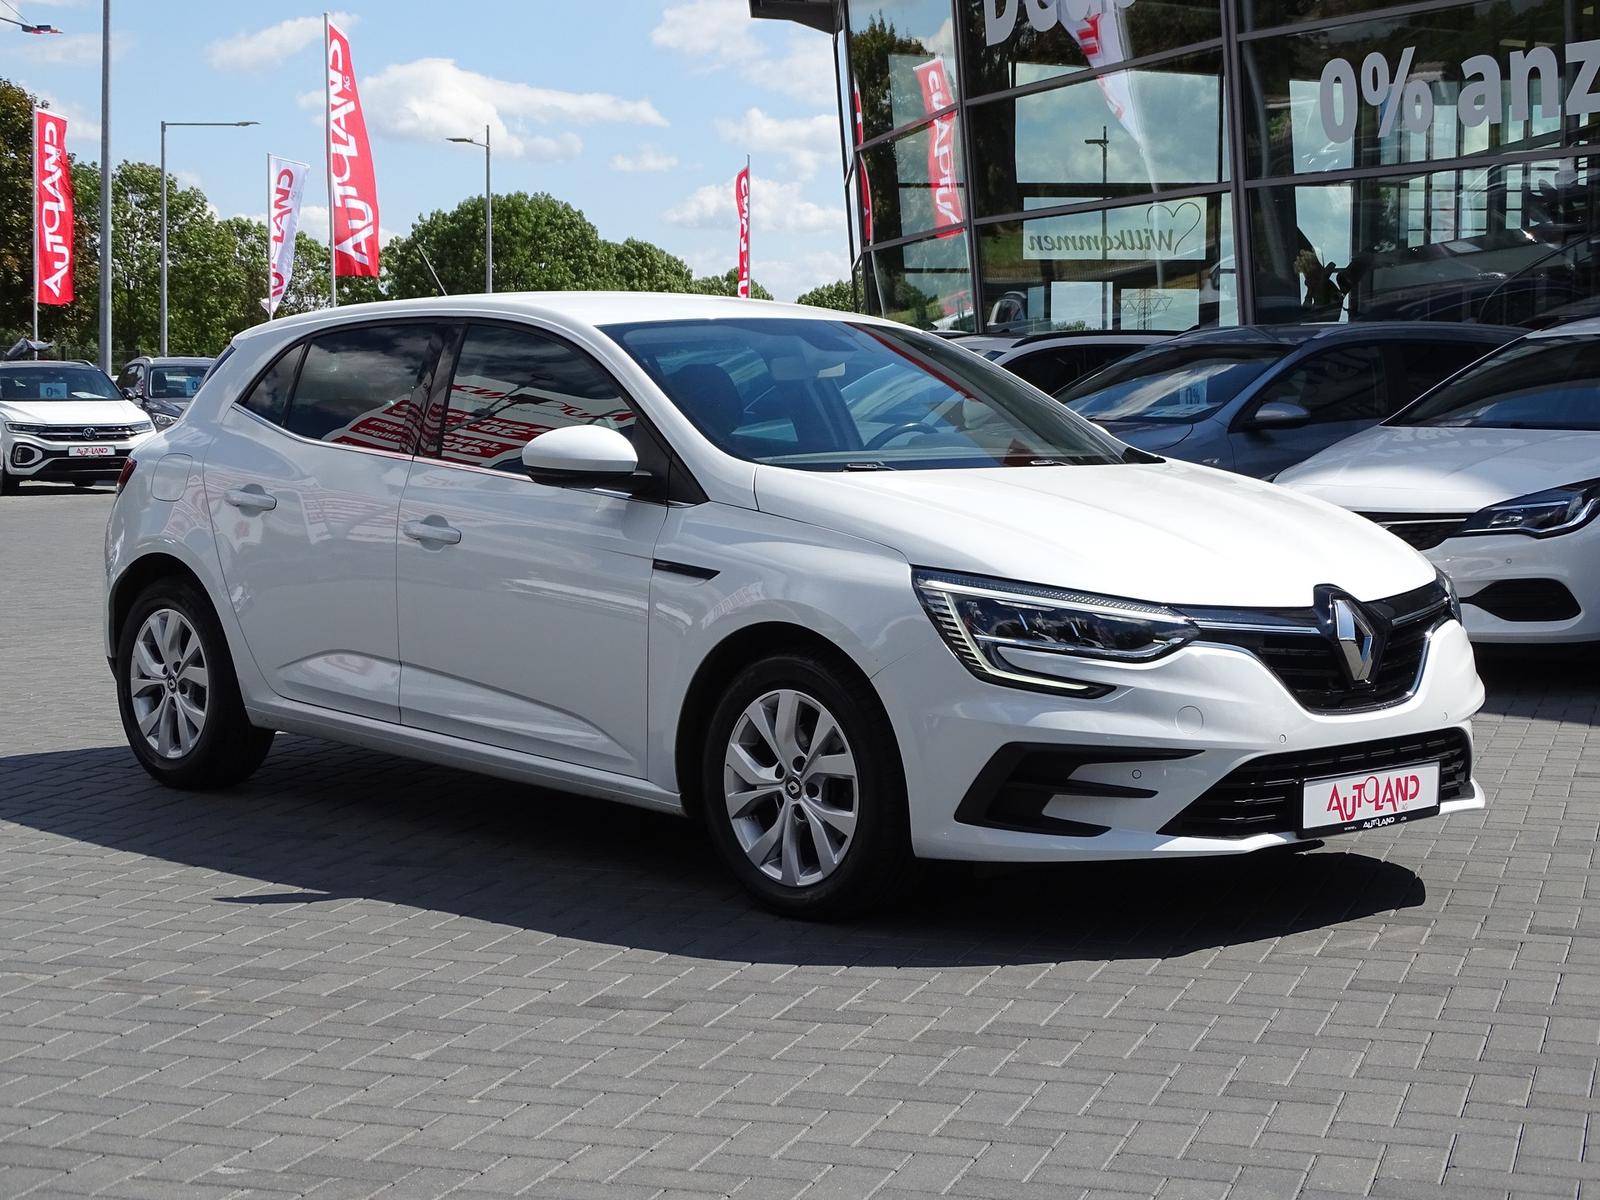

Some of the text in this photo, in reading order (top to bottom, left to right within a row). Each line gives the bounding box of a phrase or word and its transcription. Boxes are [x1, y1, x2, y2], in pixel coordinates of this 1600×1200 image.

[1319, 40, 1600, 144] 0% anz
[41, 121, 69, 297] AUTOLAND
[1327, 775, 1420, 821] AUTOLAND
